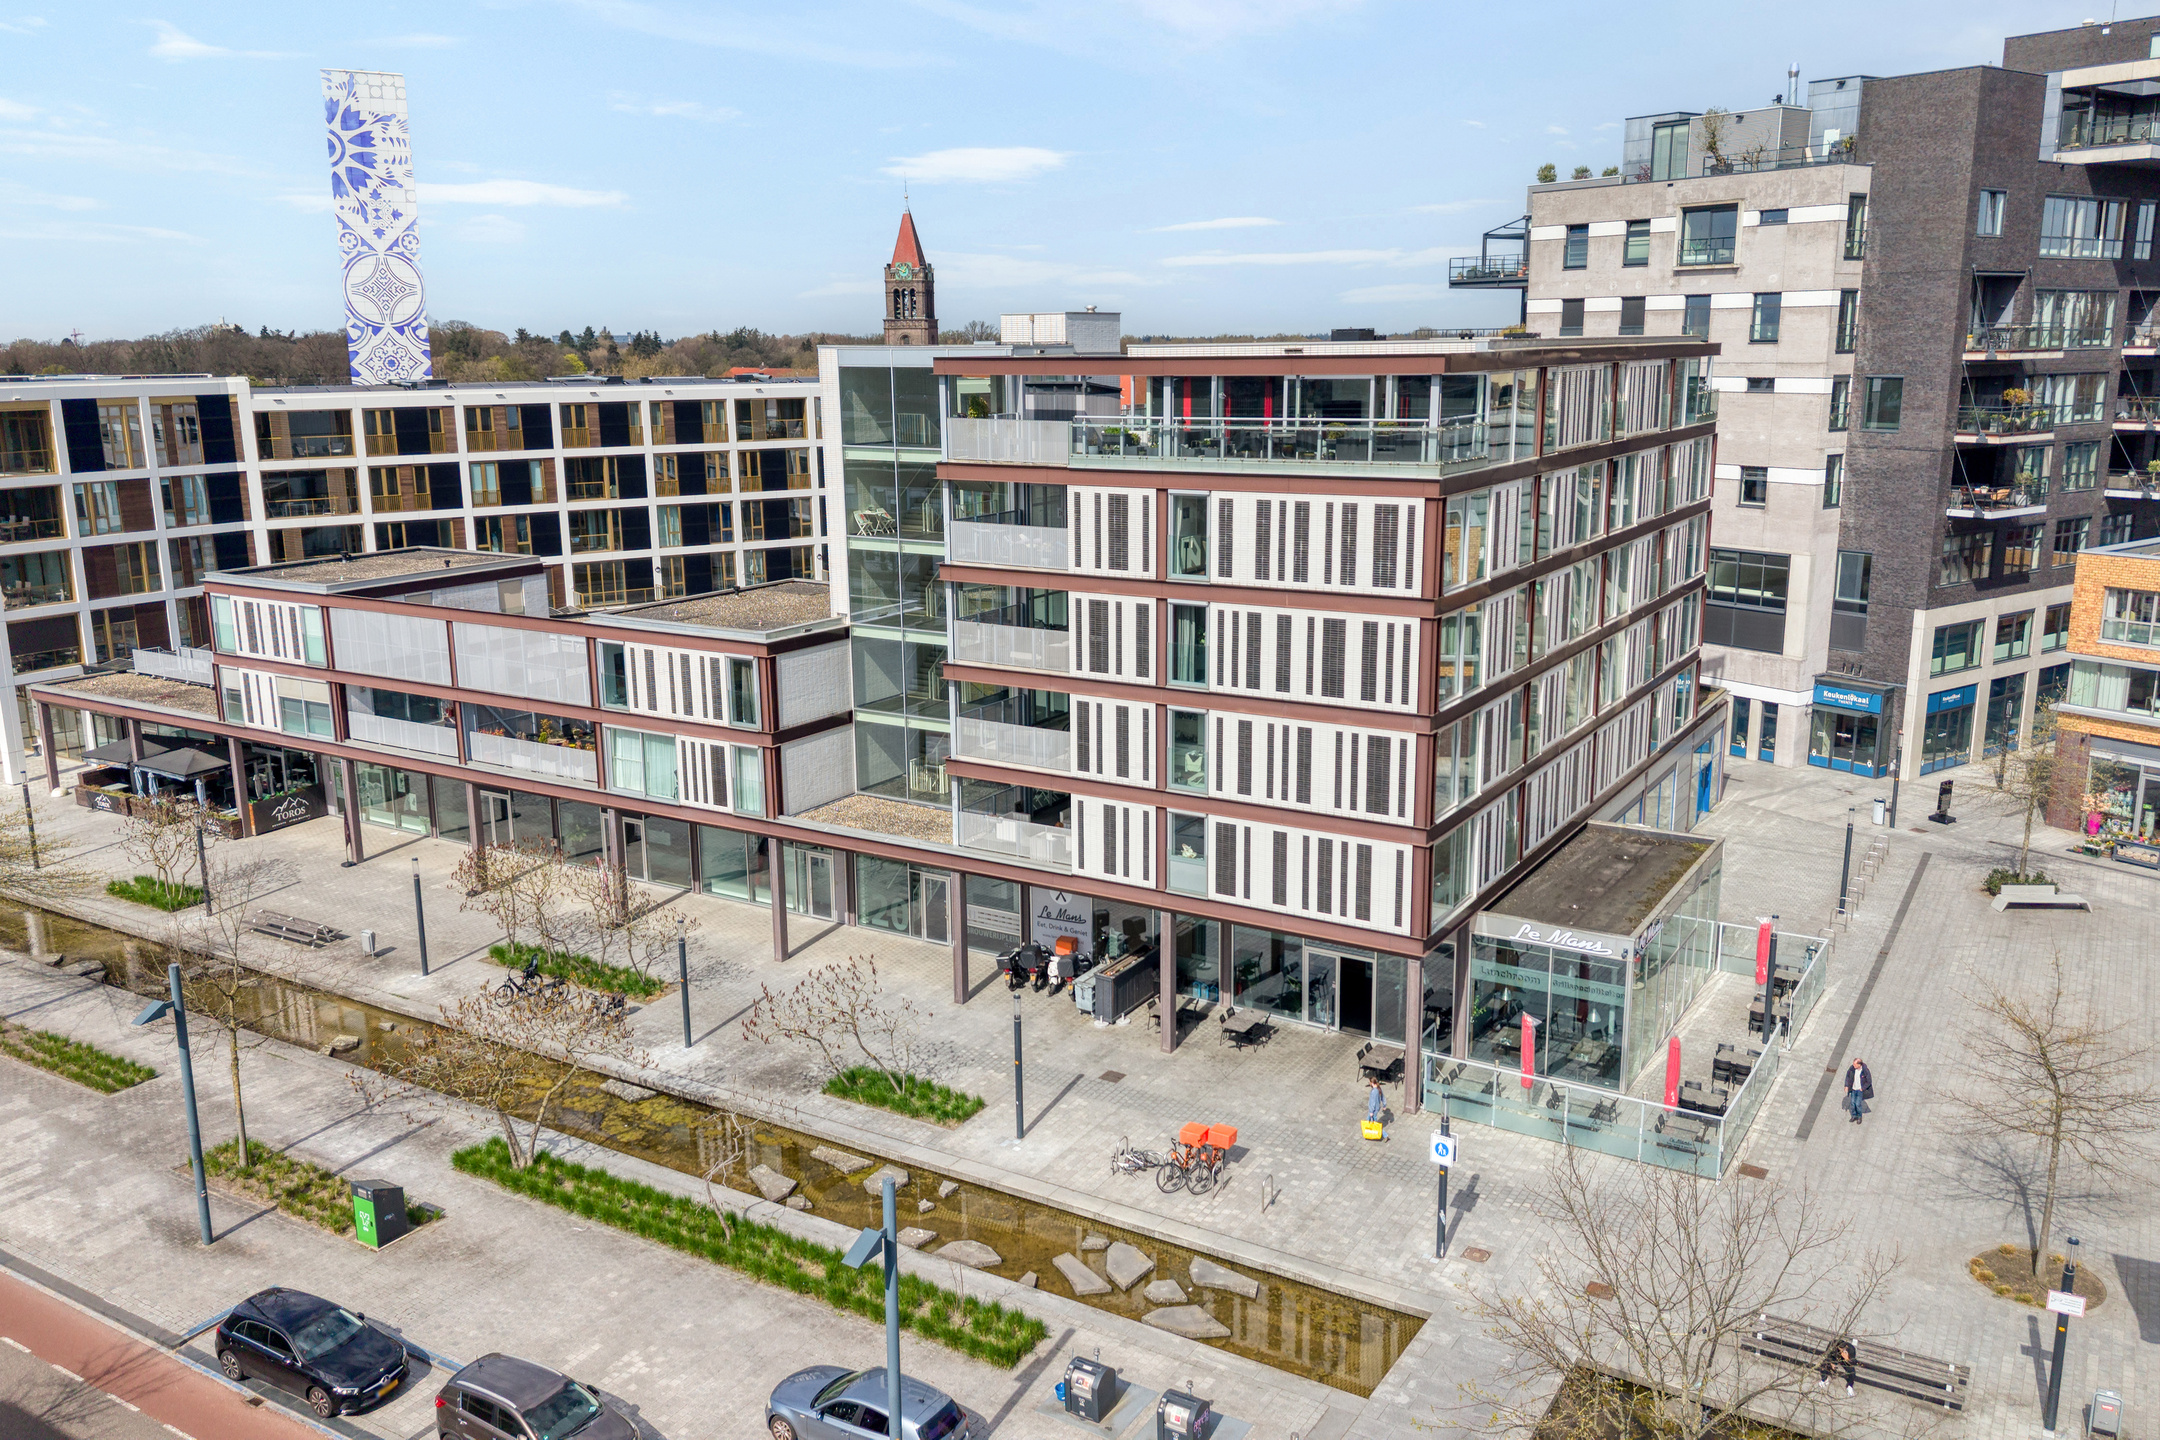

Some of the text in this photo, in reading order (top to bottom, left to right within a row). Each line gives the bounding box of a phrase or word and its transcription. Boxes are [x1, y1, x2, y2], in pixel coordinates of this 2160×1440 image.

[276, 806, 306, 821] TOROS
[871, 894, 908, 931] 20
[1037, 905, 1087, 924] Le Mans
[1509, 923, 1613, 956] Le Mans
[1481, 966, 1541, 984] Lunchroom
